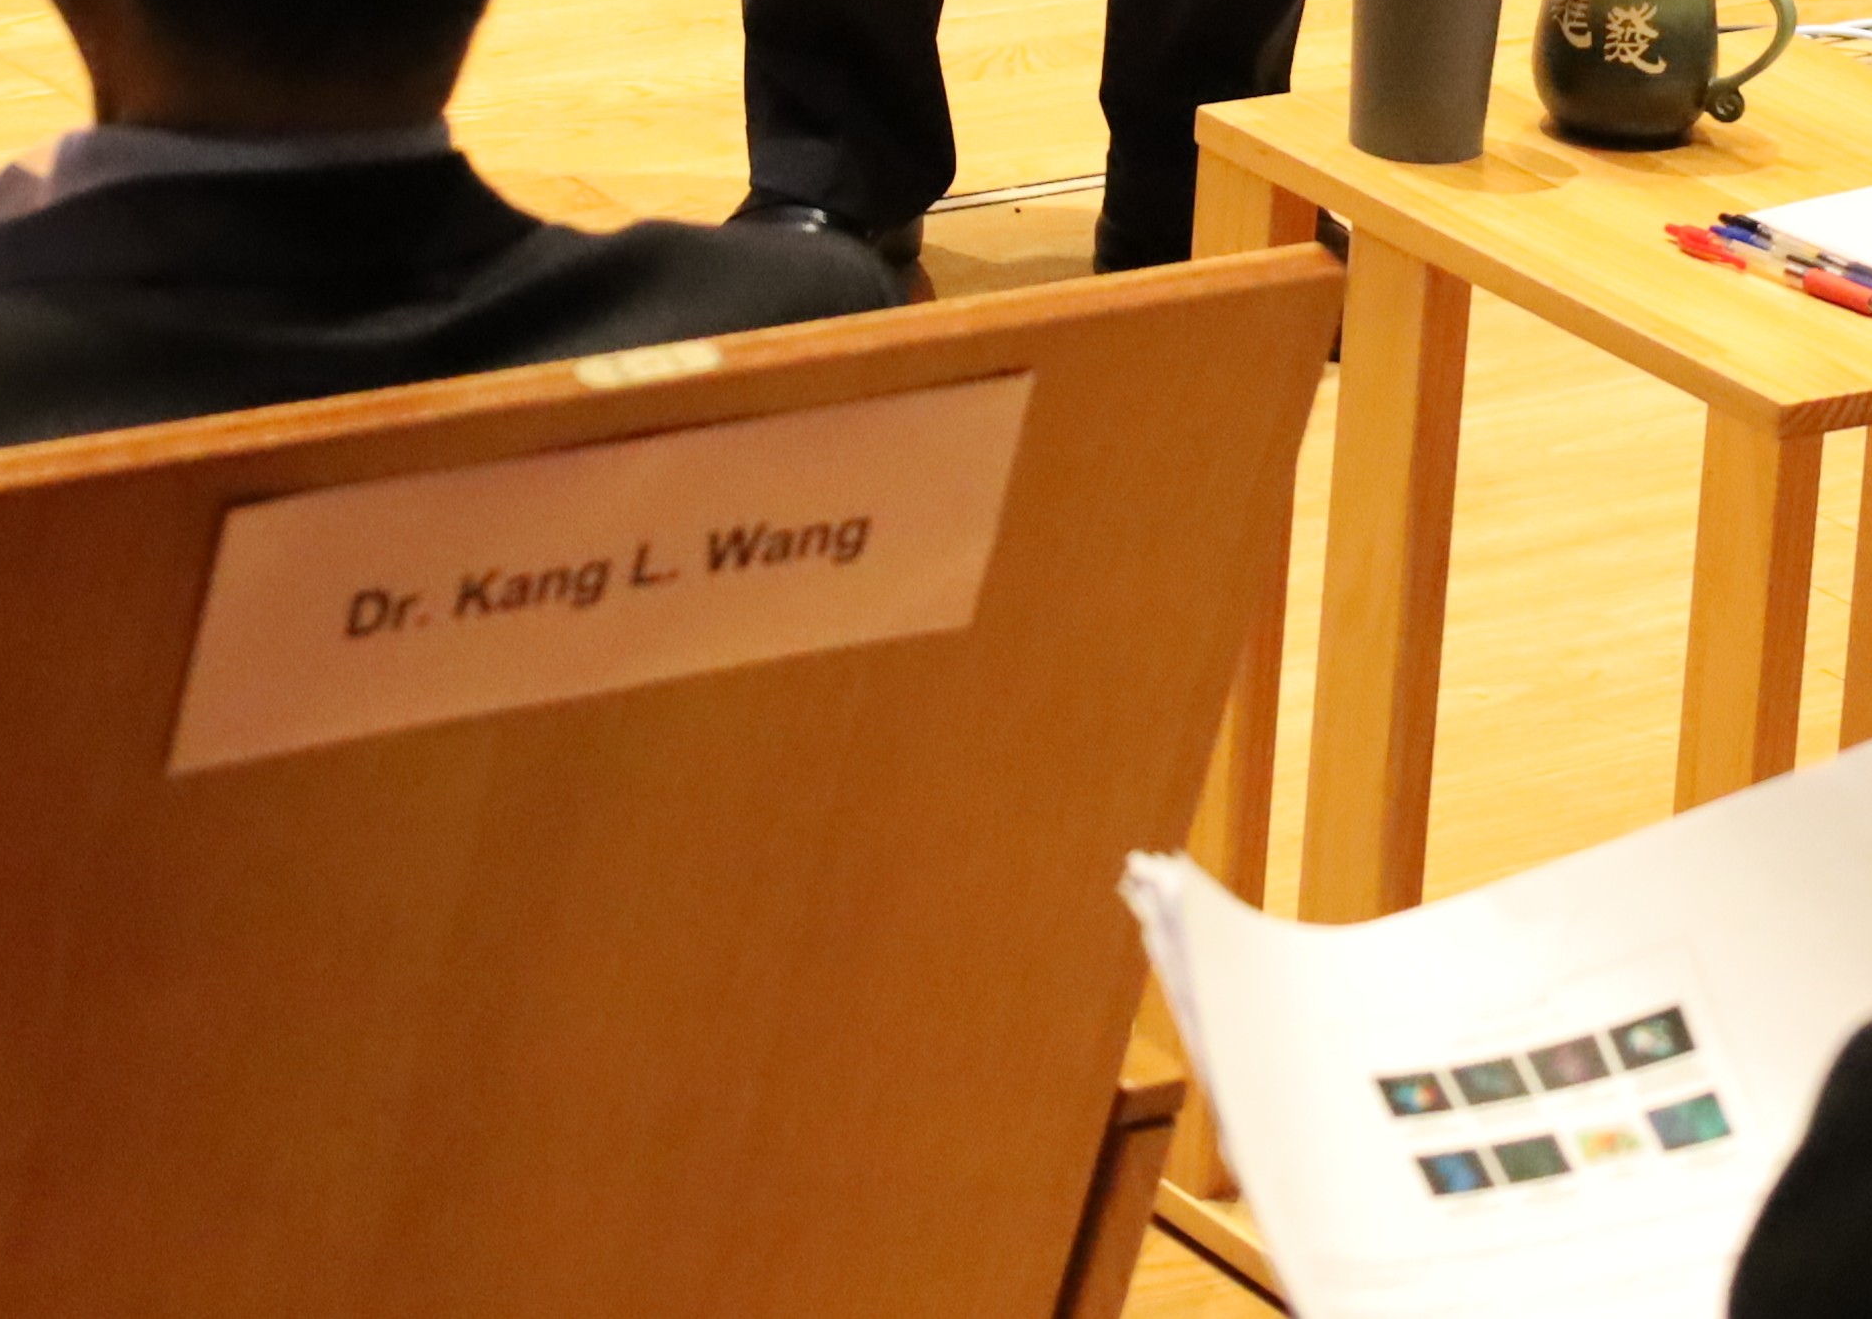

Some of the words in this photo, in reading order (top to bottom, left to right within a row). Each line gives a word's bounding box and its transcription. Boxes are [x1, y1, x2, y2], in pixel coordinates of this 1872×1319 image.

[343, 586, 430, 641] Dr.
[453, 558, 613, 621] Kang
[631, 538, 680, 589] L.
[705, 514, 872, 575] Wang
